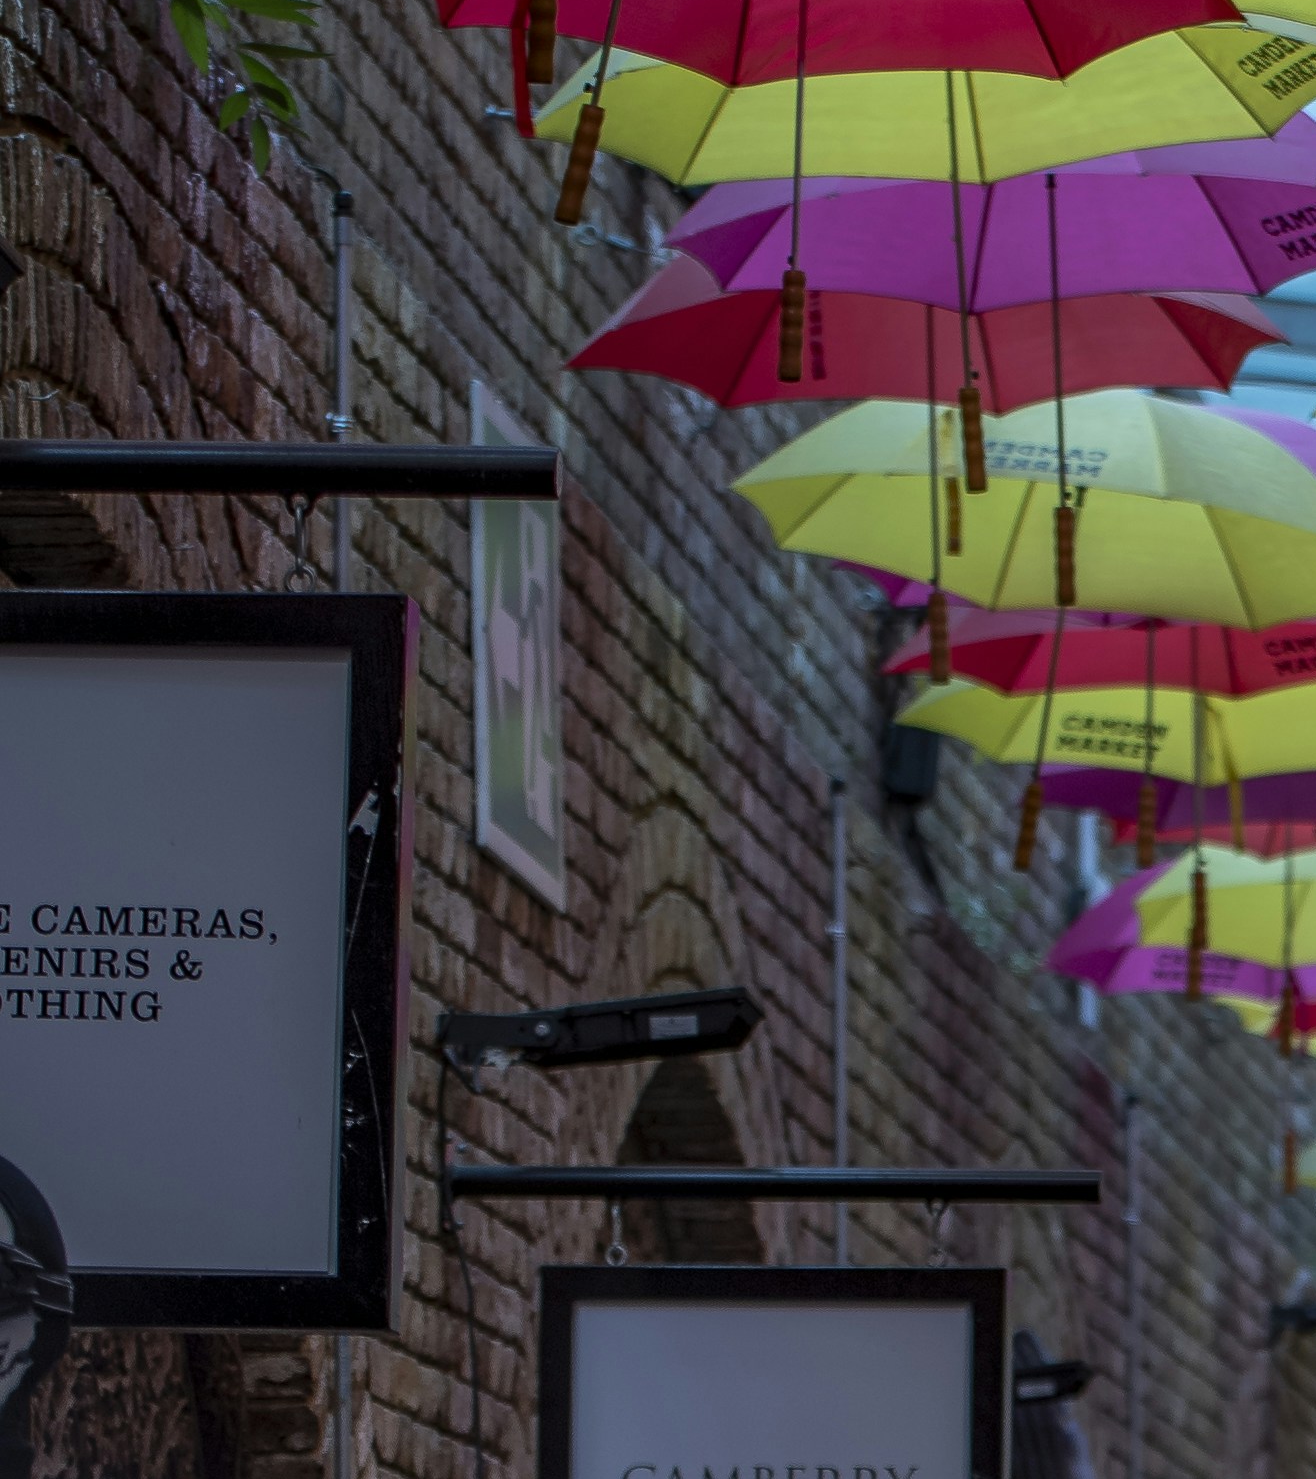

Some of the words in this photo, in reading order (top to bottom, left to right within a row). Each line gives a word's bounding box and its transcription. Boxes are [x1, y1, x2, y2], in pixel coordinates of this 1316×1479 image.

[31, 904, 278, 945] CAMERAS,
[169, 949, 203, 981] &
[0, 989, 162, 1022] THING
